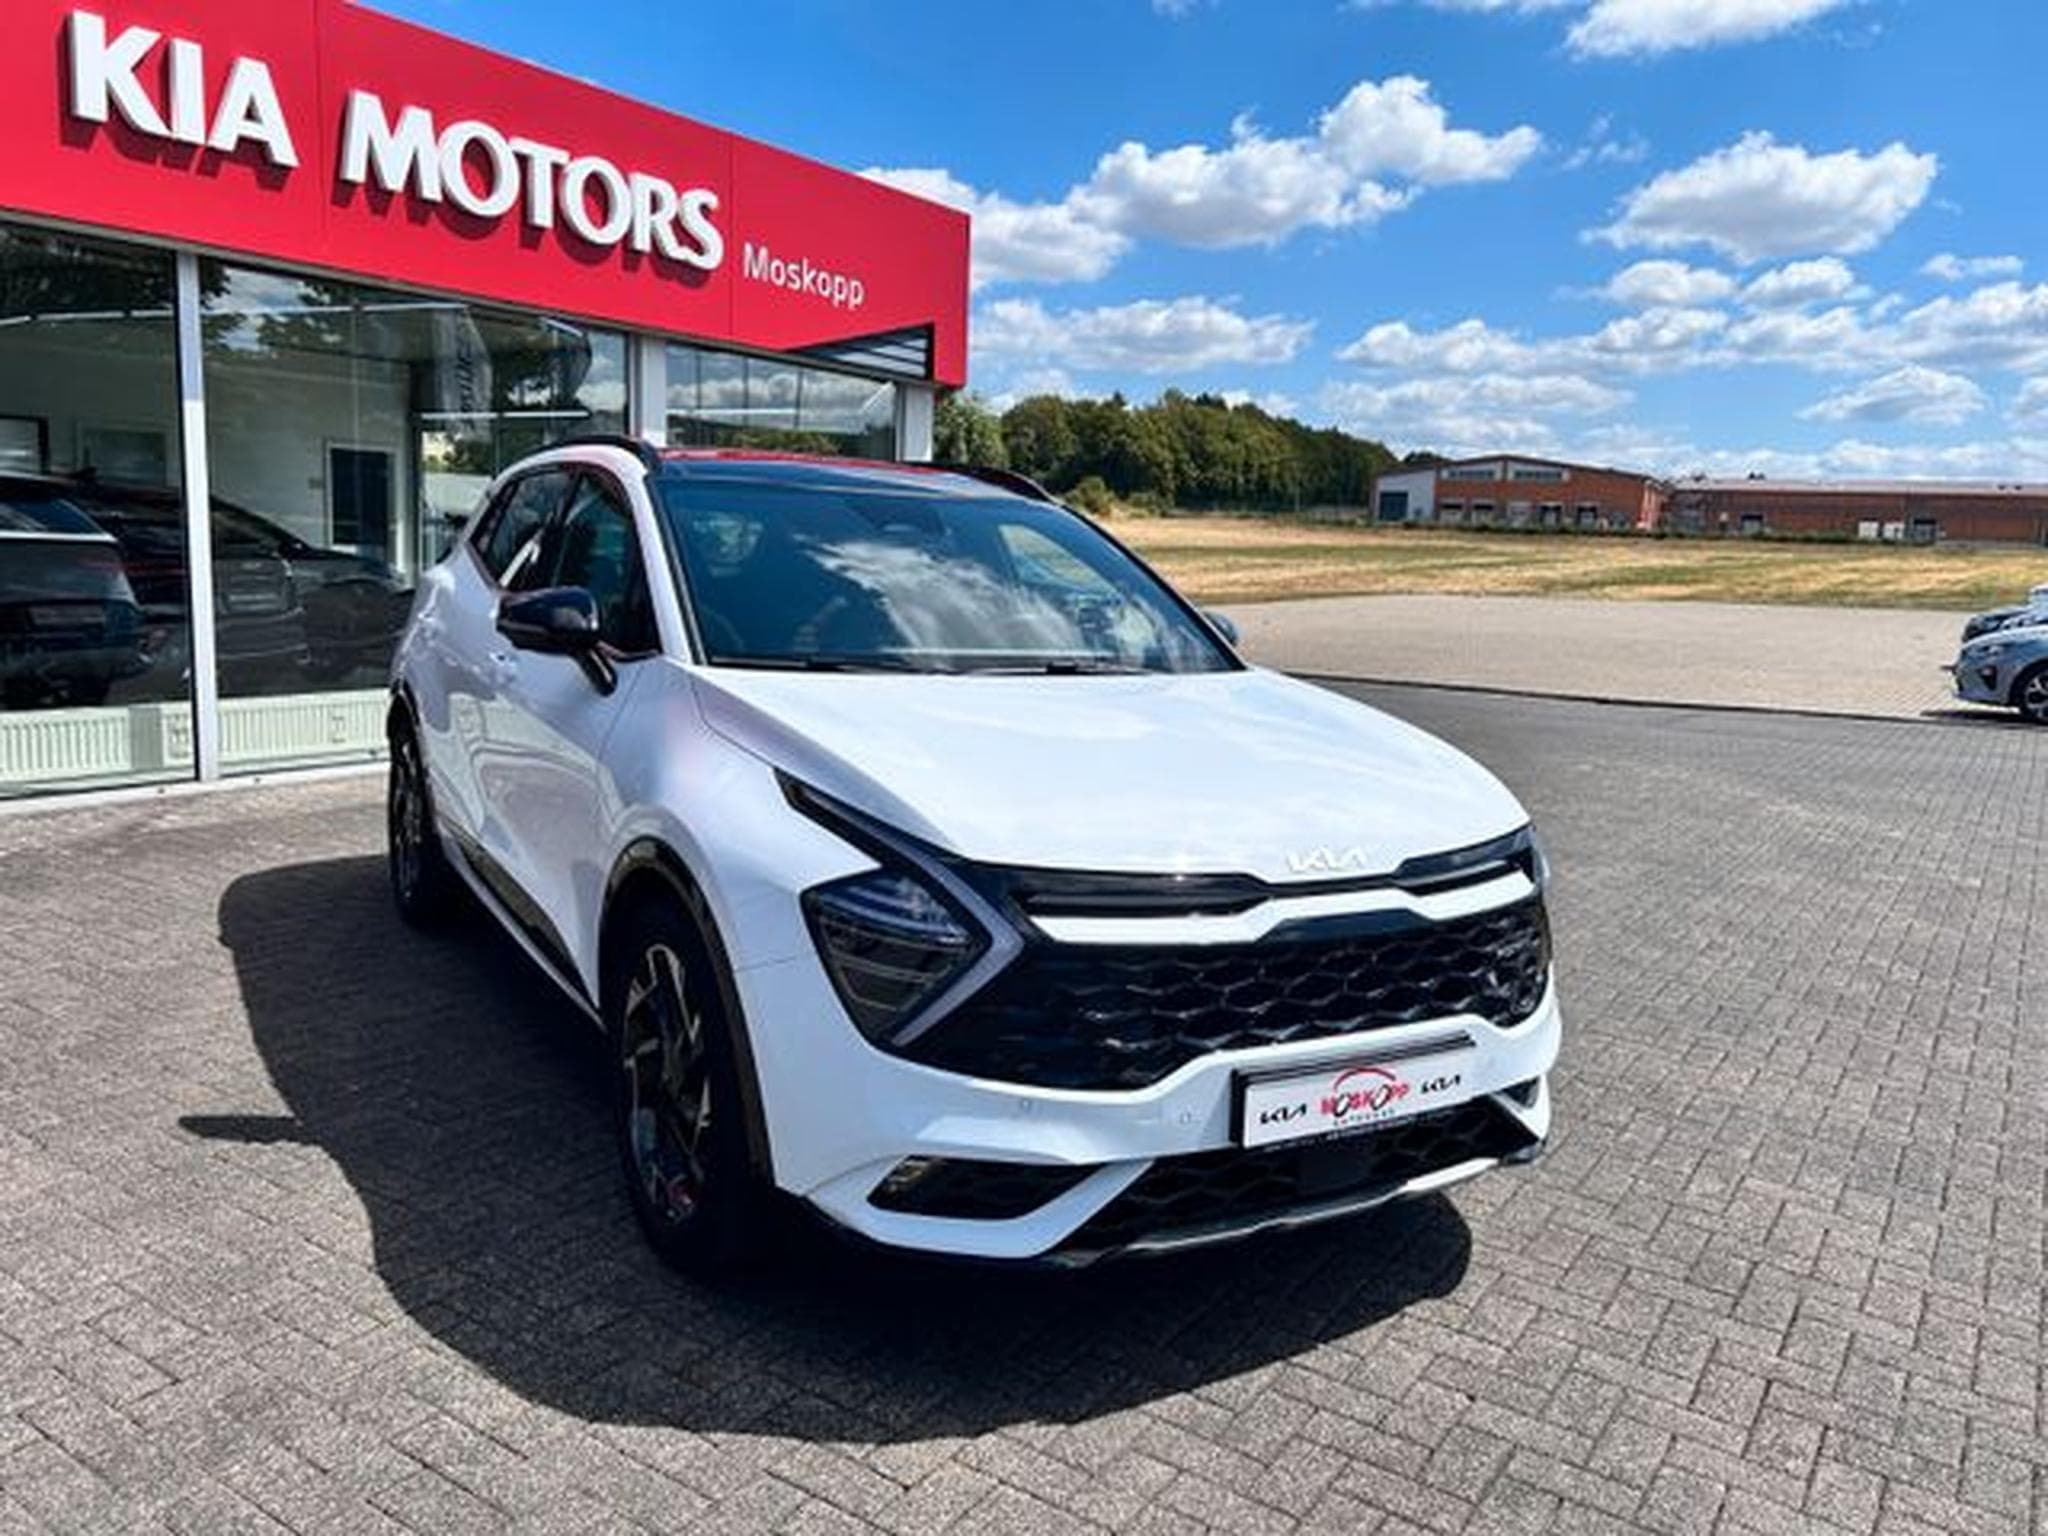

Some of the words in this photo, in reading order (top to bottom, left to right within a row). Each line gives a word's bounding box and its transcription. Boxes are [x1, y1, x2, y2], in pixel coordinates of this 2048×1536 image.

[71, 8, 300, 168] KIA
[339, 88, 724, 271] MOTORS
[743, 241, 865, 311] Moskopp
